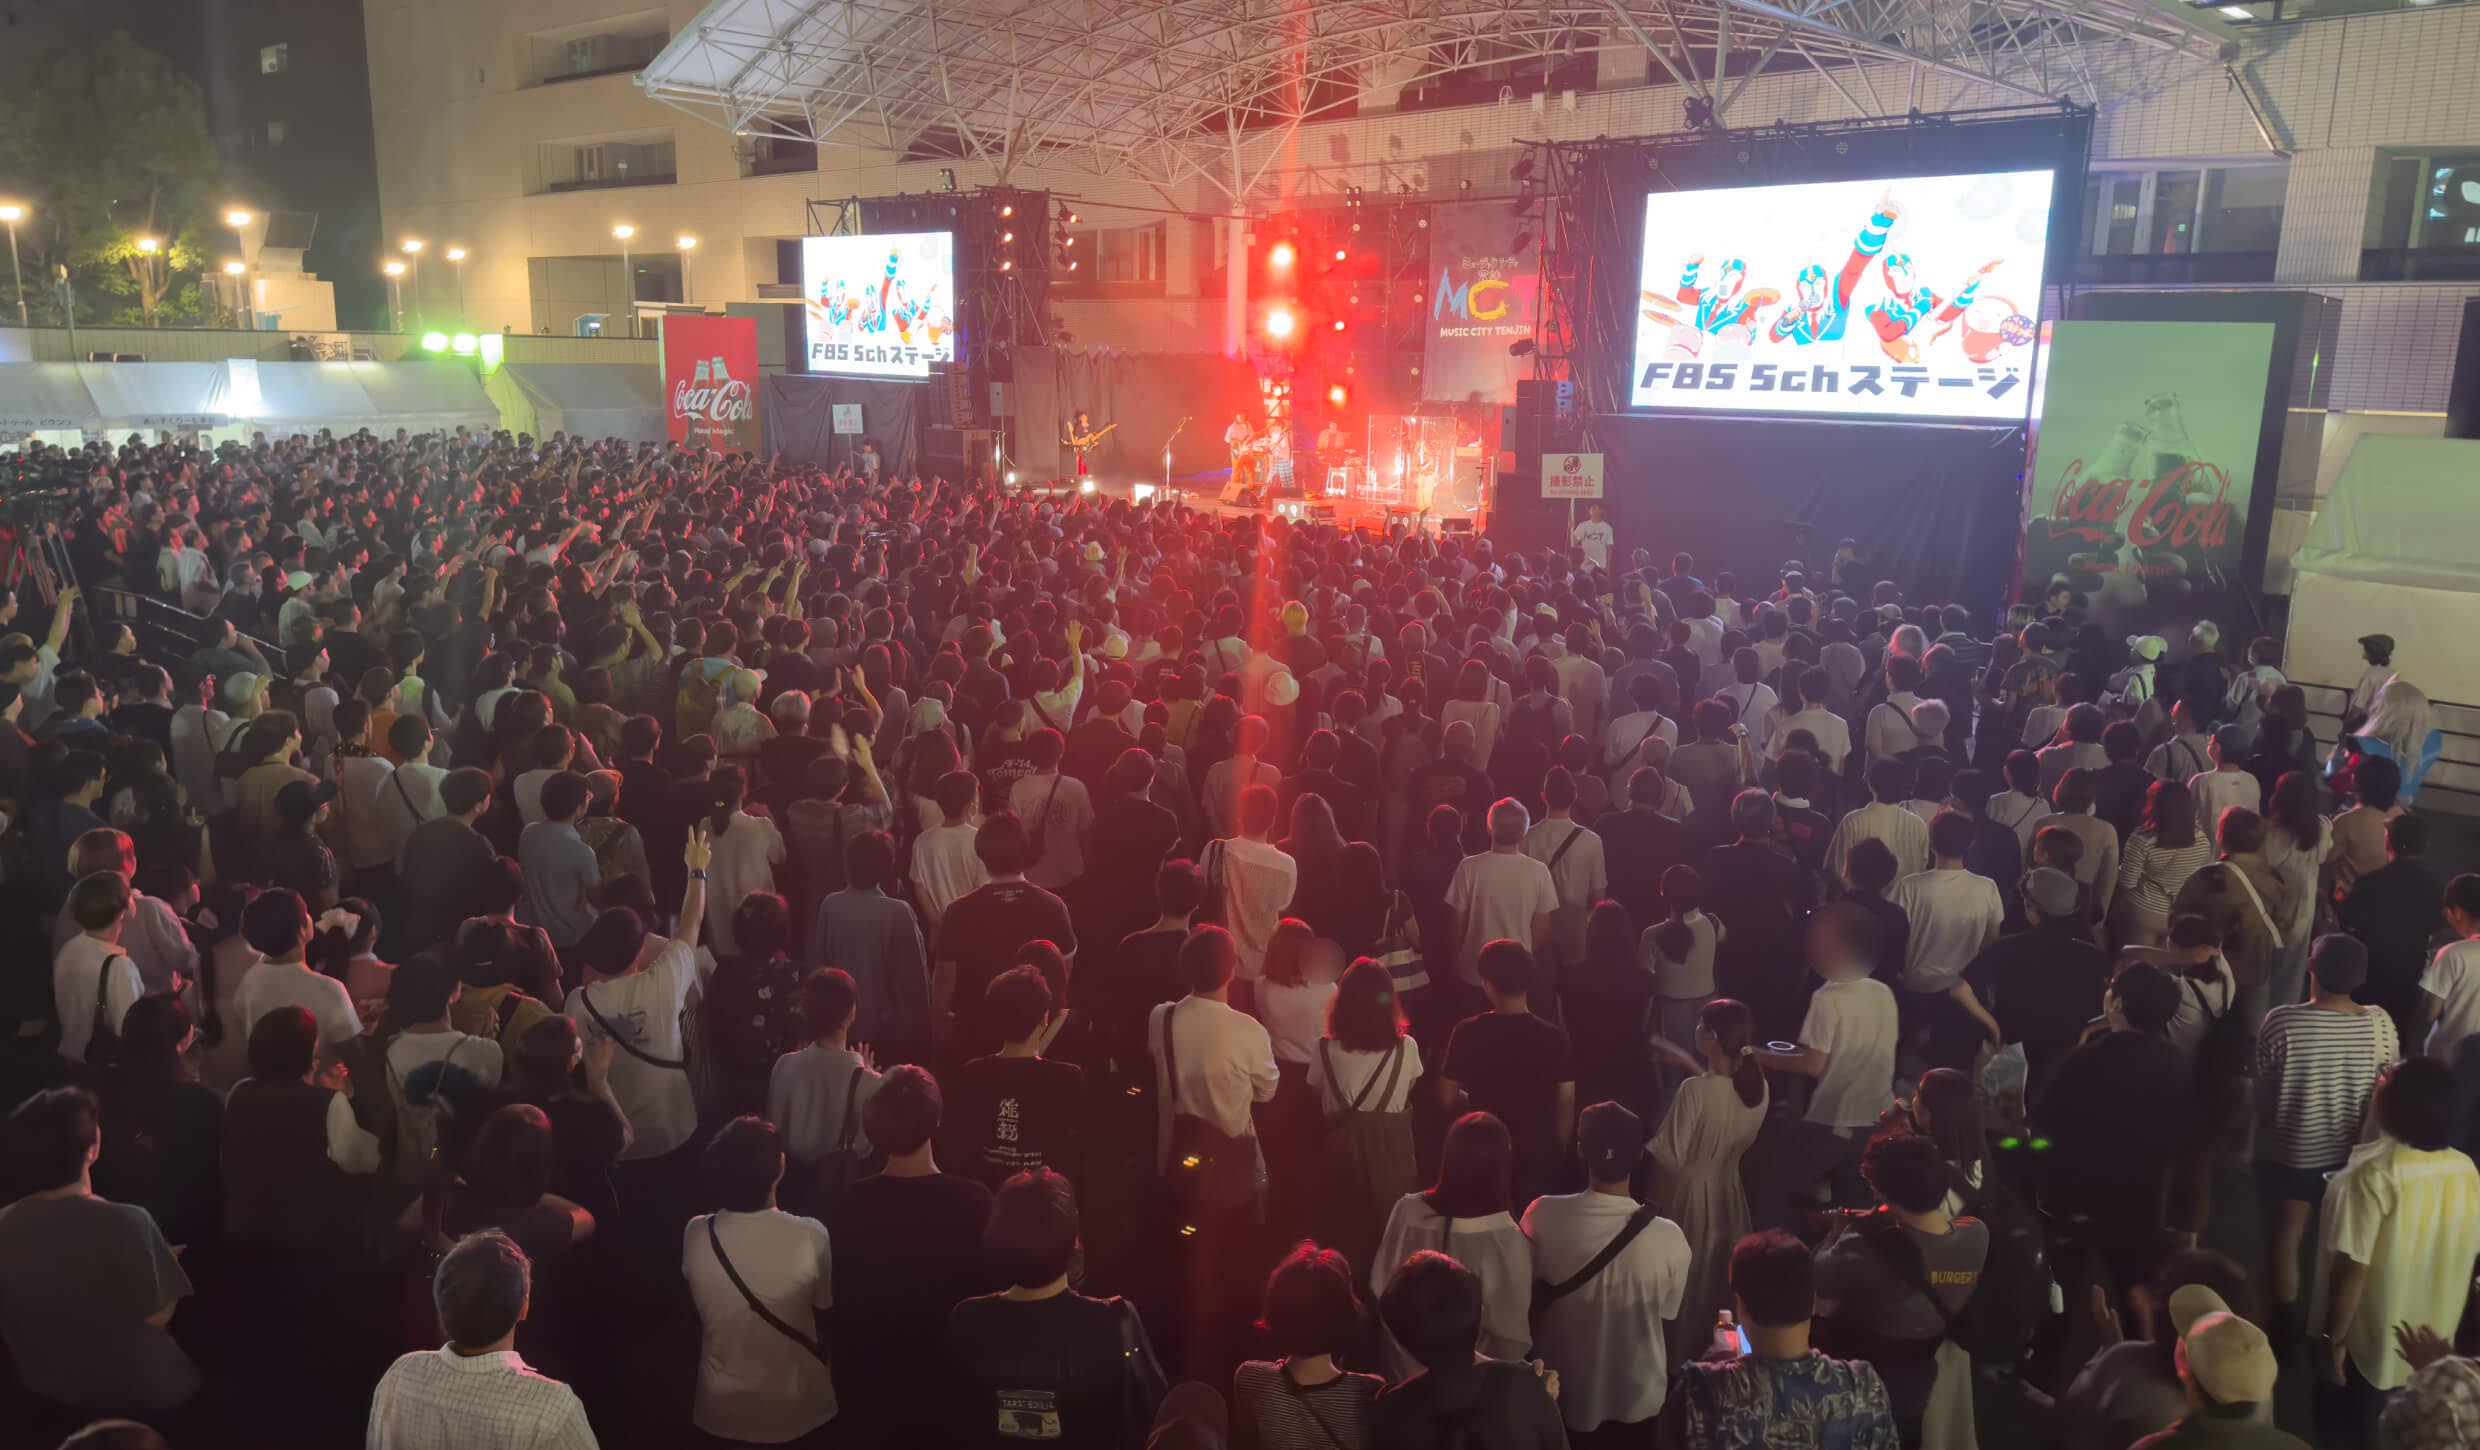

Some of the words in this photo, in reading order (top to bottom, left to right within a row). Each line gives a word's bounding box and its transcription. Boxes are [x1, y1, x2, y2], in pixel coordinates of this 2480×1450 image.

[1440, 327, 1470, 337] MUSIC
[1471, 327, 1493, 336] CITY
[1495, 324, 1531, 335] TENJIN
[811, 343, 849, 361] FBS
[1640, 362, 1738, 390] FBS
[674, 379, 753, 421] Coca-Cola
[2048, 458, 2232, 547] Coca-Cola
